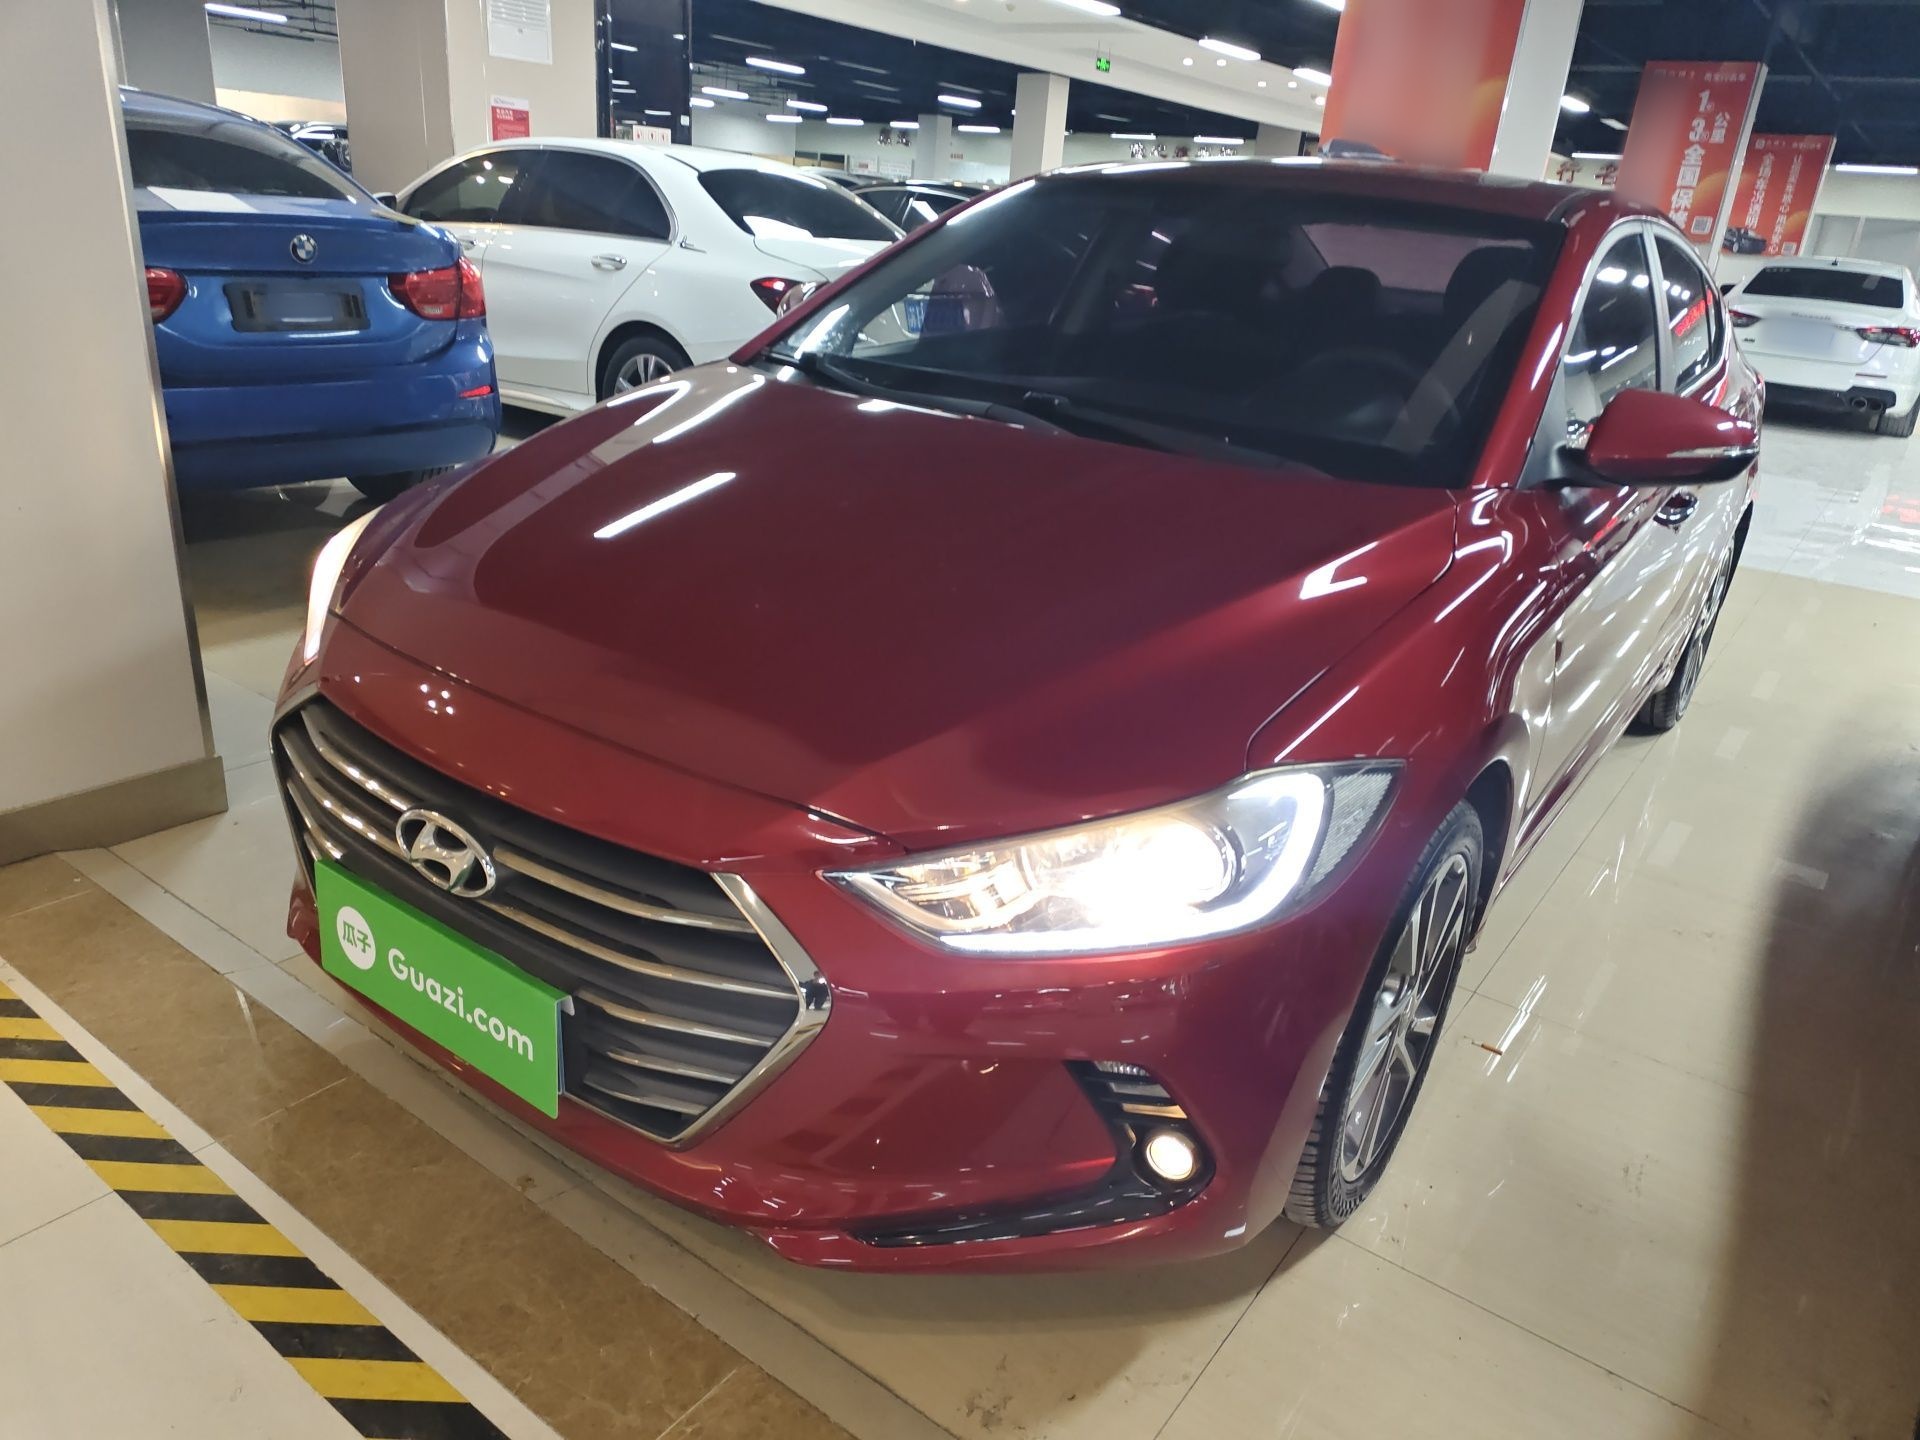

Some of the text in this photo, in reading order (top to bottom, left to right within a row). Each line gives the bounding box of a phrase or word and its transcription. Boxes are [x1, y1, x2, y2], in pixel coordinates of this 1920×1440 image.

[1709, 112, 1731, 144] 公里
[342, 919, 371, 954] 瓜子
[388, 948, 535, 1062] Guazi.com
